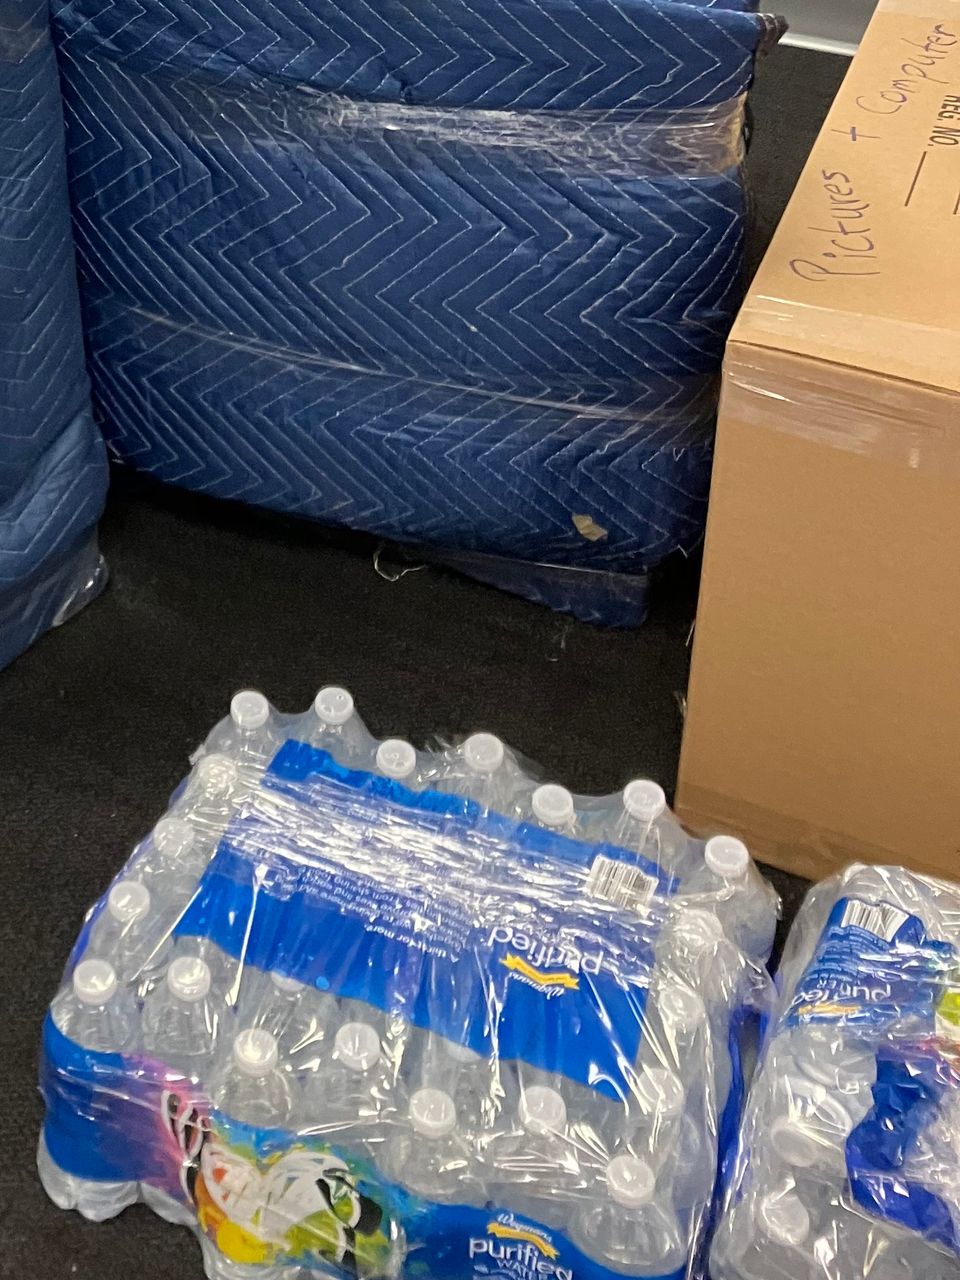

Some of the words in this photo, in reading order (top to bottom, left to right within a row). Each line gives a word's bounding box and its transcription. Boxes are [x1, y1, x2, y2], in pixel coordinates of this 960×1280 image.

[789, 169, 881, 282] Pictures
[856, 23, 958, 115] Computer
[469, 1237, 573, 1280] purified
